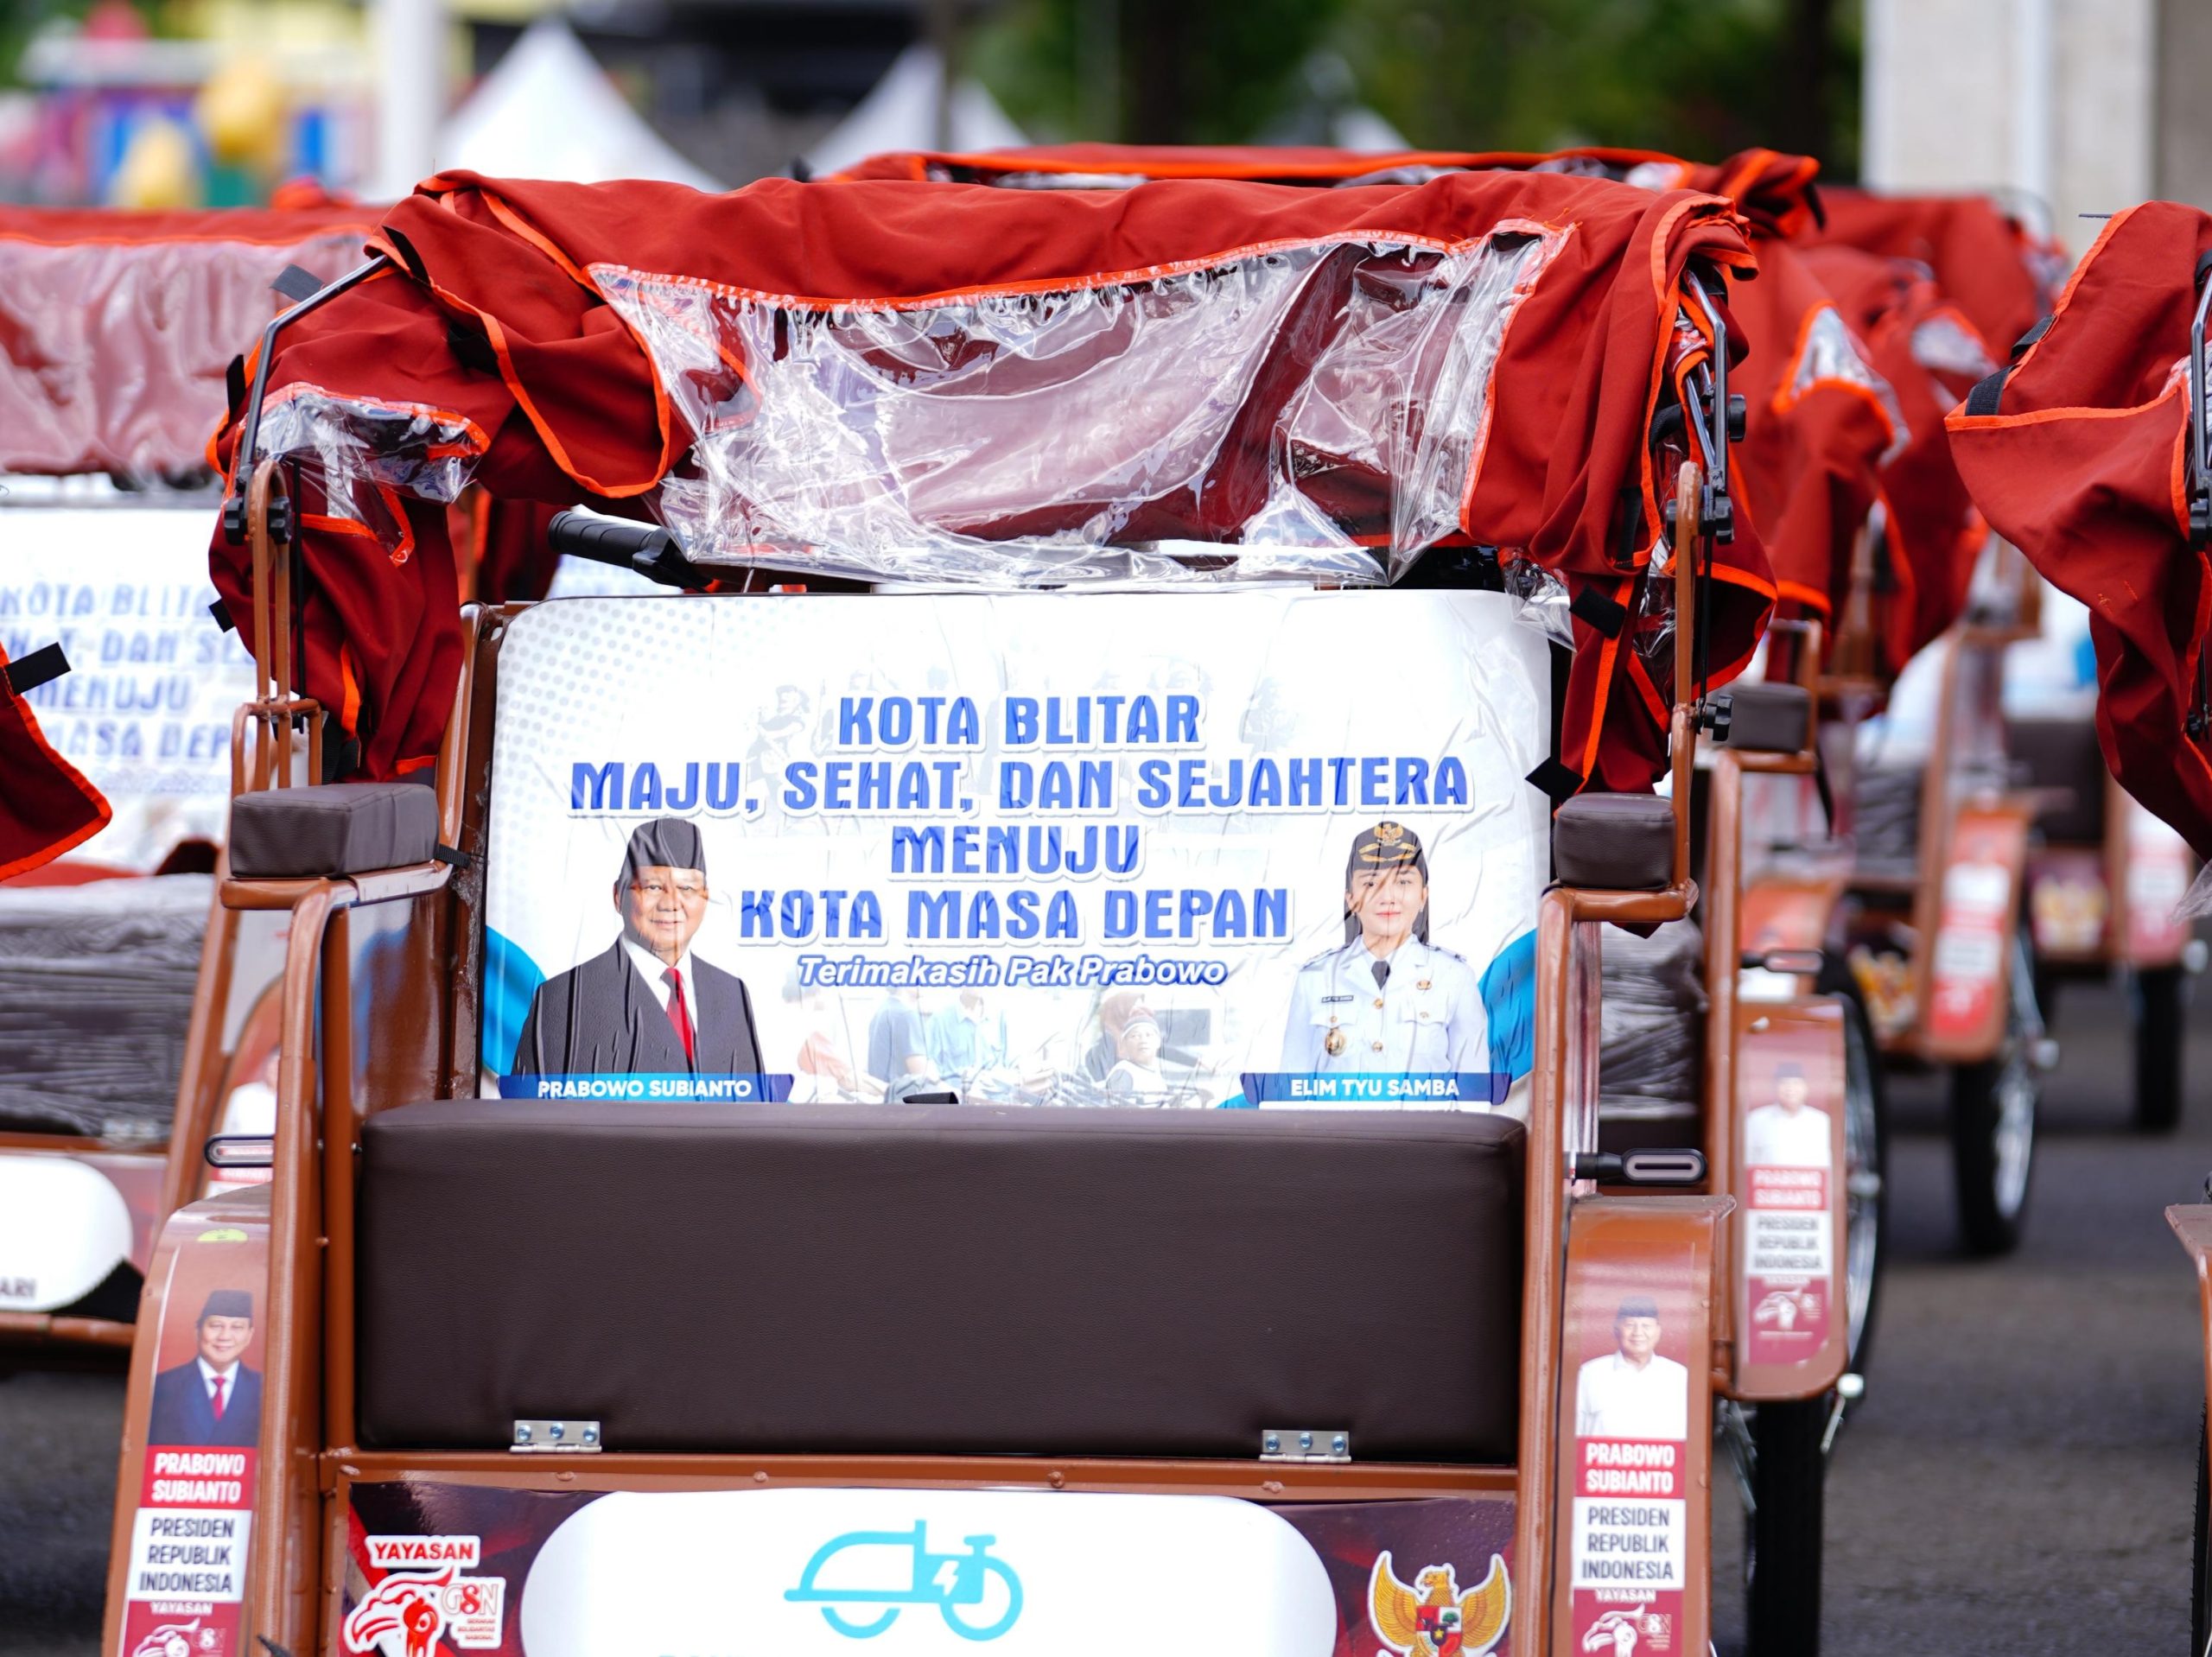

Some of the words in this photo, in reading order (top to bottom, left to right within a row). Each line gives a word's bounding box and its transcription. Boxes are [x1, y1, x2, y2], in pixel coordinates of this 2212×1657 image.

[1, 582, 95, 617] KOTA
[110, 582, 217, 618] BLITA
[100, 629, 180, 663] DAN
[840, 697, 979, 745] KOTA
[1006, 695, 1199, 745] BLITAR
[572, 762, 757, 812] MAJU,
[785, 762, 973, 812] SEHAT,
[1000, 760, 1112, 809] DAN
[1138, 757, 1468, 809] SEJAHTERA
[892, 826, 1139, 873] MENUJU
[741, 891, 882, 938] KOTA
[907, 891, 1078, 939] MASA
[1104, 889, 1287, 938] DEPAN
[799, 956, 999, 986] Terimakasih
[1007, 956, 1071, 986] Pak
[1078, 955, 1227, 986] Prabowo
[537, 1081, 644, 1098] PRABOWO
[649, 1080, 752, 1097] SUBIANTO
[1291, 1079, 1337, 1096] ELIM
[1342, 1079, 1382, 1096] TYU
[1387, 1079, 1460, 1096] SAMBA
[153, 1452, 245, 1477] PRABOWO
[1585, 1442, 1675, 1468] PRABOWO
[150, 1479, 242, 1504] SUBIANTO
[1585, 1470, 1675, 1495] SUBIANTO
[149, 1517, 235, 1538] PRESIDEN
[1587, 1506, 1669, 1527] PRESIDEN
[374, 1542, 473, 1559] YAYASAN
[1587, 1532, 1669, 1553] REPUBLIK
[147, 1544, 232, 1565] REPUBLIK
[1581, 1559, 1675, 1581] INDONESIA
[138, 1571, 233, 1593] INDONESIA
[1595, 1590, 1656, 1604] YAYASAN
[149, 1602, 213, 1616] YAYASAN
